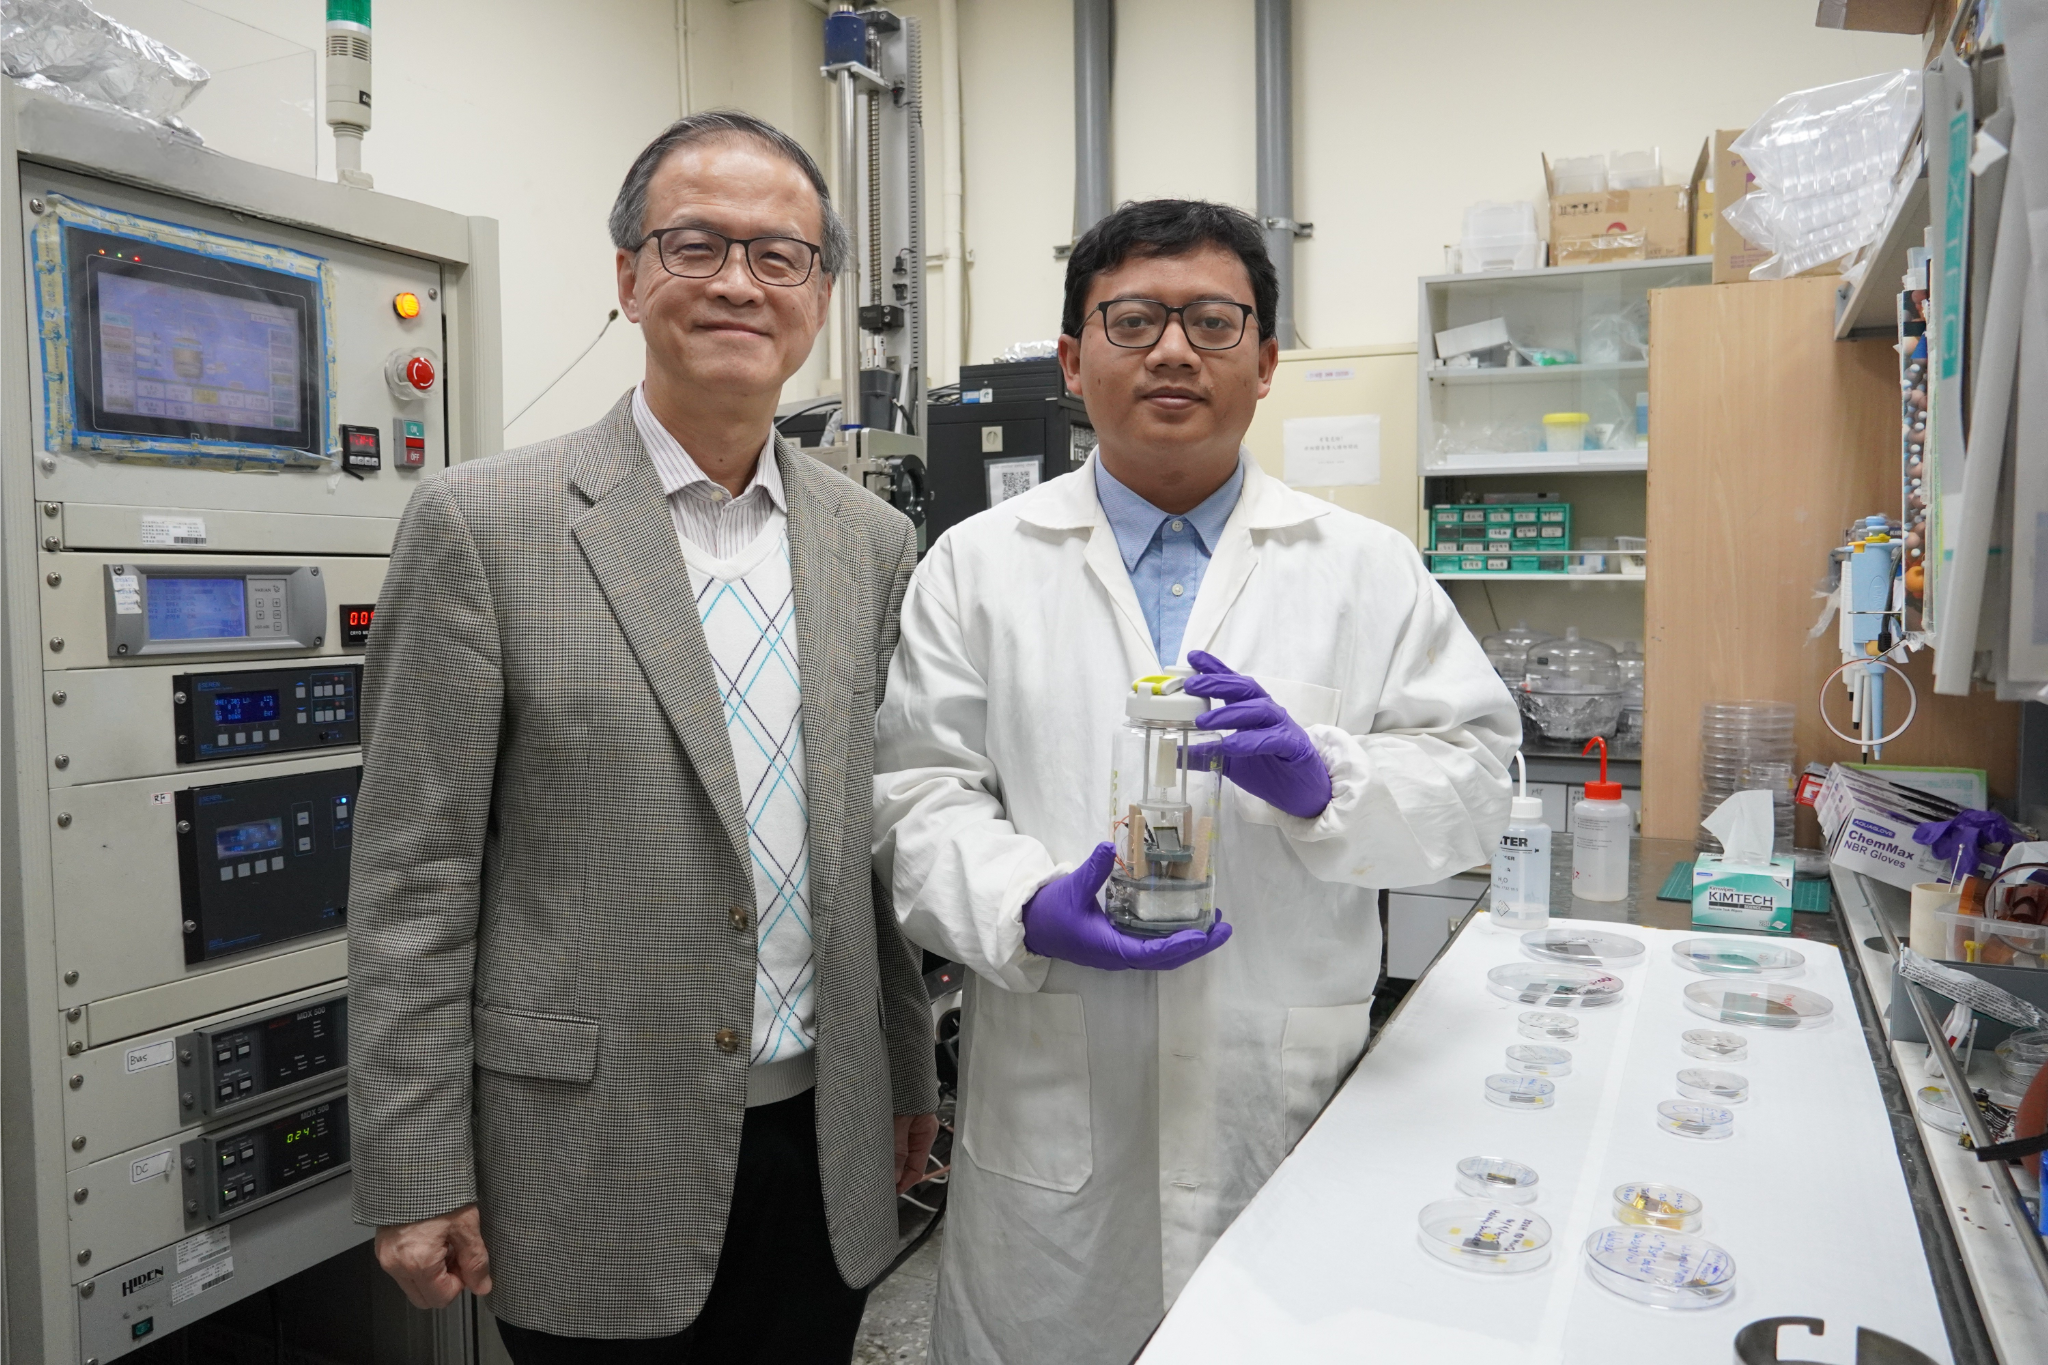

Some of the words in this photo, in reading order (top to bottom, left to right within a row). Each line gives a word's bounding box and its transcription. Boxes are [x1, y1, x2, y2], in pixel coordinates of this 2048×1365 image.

[410, 453, 420, 461] OFF
[1853, 820, 1893, 836] AQUAGLOVE
[1499, 835, 1529, 848] TER
[1848, 829, 1915, 861] ChemMax
[1843, 840, 1868, 855] NBR
[1869, 849, 1906, 869] Gloves
[1708, 891, 1773, 906] KIMTECH
[296, 1009, 313, 1021] MDX
[313, 1006, 326, 1016] 500
[300, 1109, 316, 1121] MDX
[317, 1104, 330, 1114] 500
[286, 1127, 310, 1144] 024
[135, 1163, 149, 1176] DC
[121, 1265, 164, 1298] HIDEN
